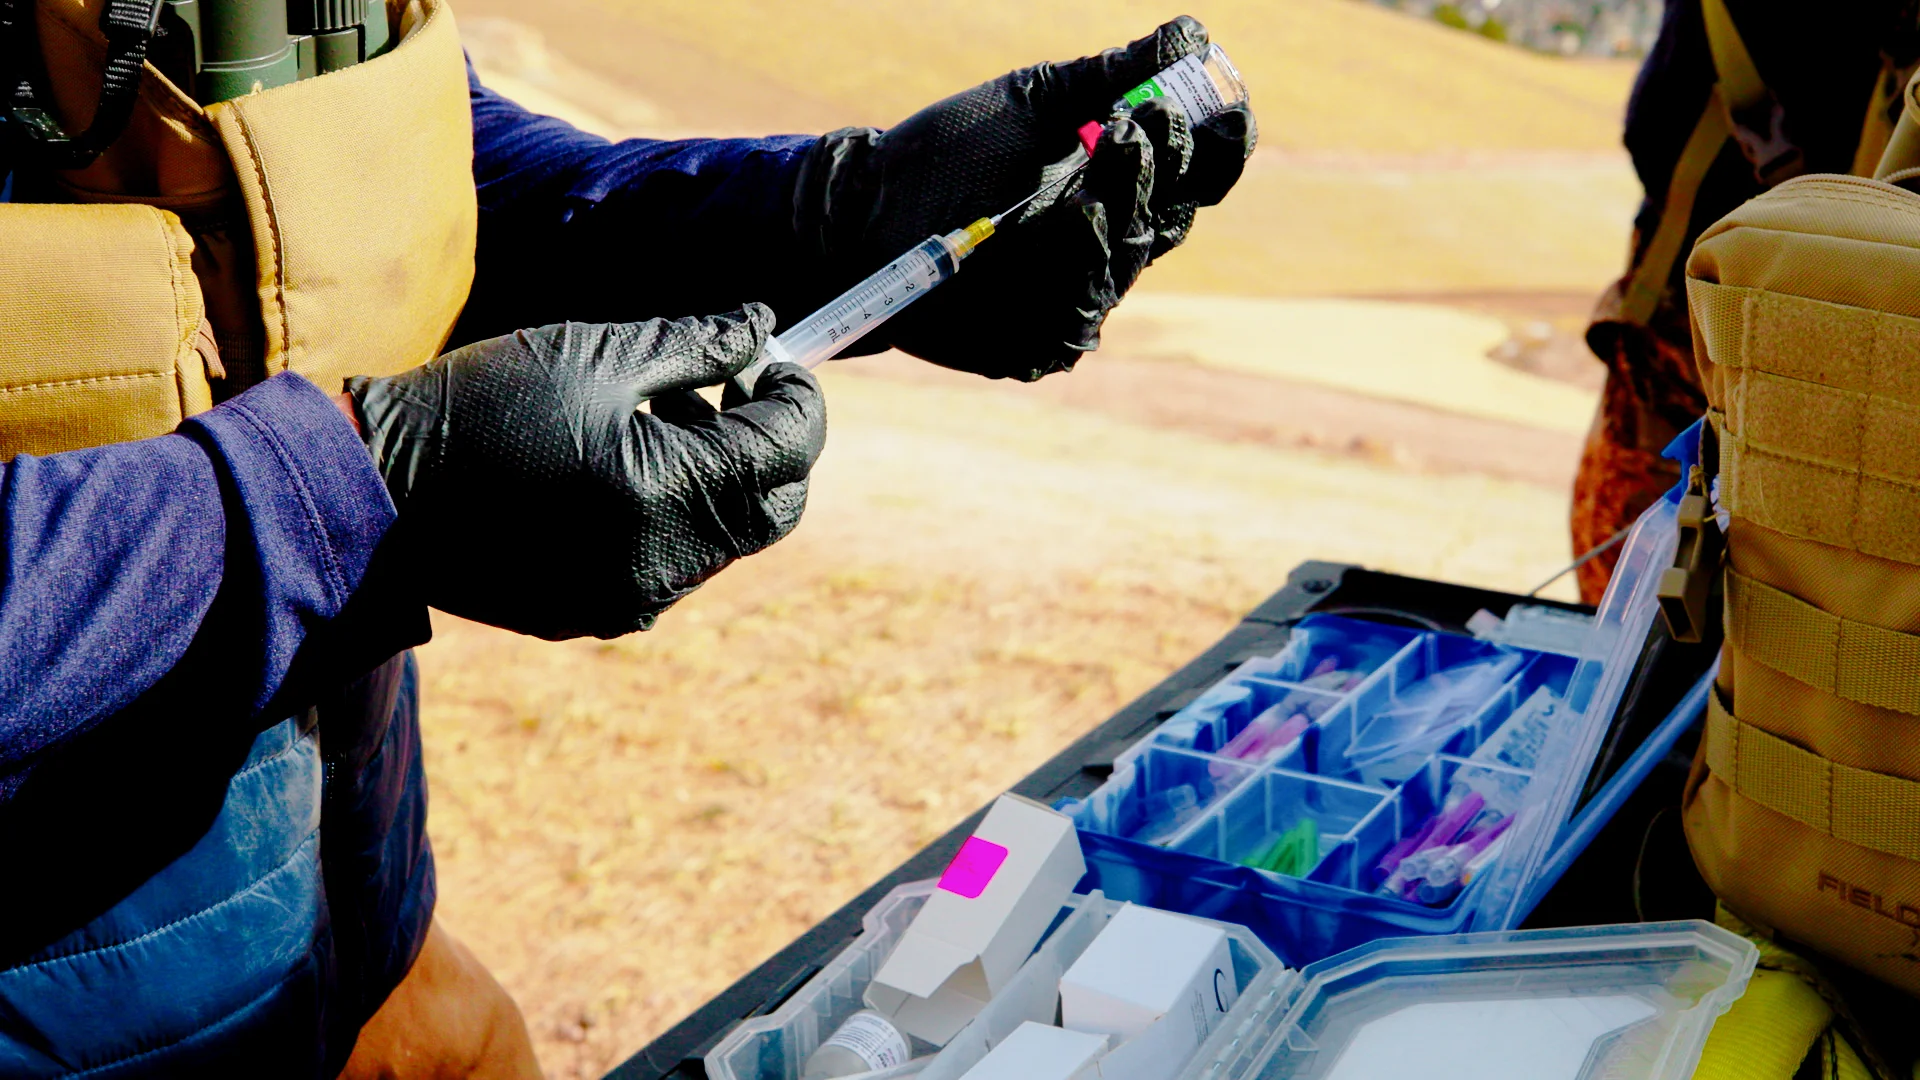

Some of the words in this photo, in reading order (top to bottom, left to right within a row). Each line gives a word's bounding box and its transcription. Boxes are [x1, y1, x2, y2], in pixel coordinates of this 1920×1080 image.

[928, 269, 936, 277] 1
[905, 283, 915, 292] 2
[884, 297, 894, 306] 3
[841, 325, 850, 334] 5
[827, 328, 840, 343] mL
